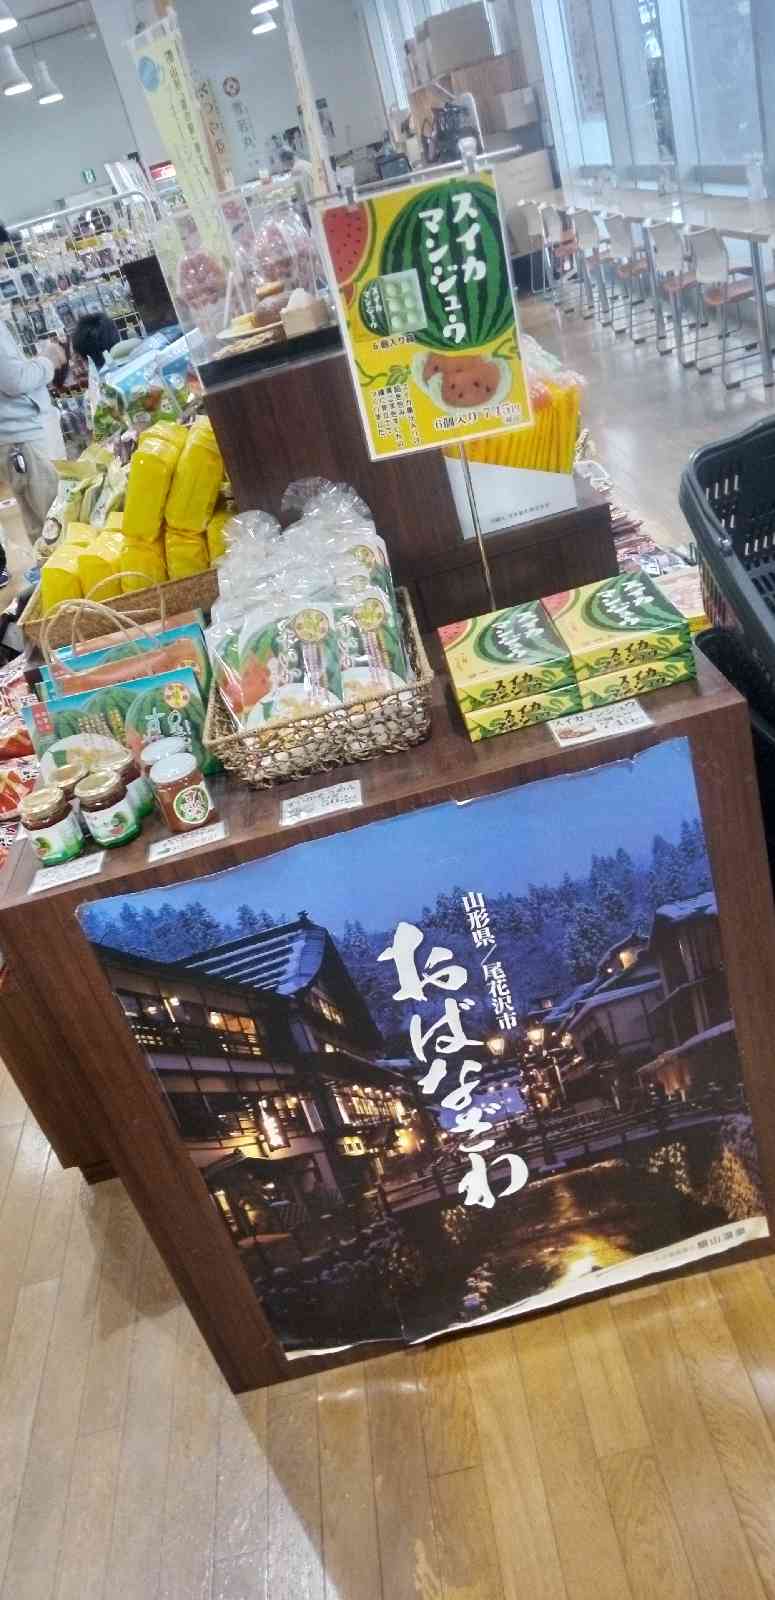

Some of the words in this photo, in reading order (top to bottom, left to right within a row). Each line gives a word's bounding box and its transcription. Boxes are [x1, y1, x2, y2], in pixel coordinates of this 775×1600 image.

[451, 192, 487, 284] スイカ
[418, 207, 467, 344] マンジュウ
[609, 638, 650, 660] スイカ
[495, 671, 534, 690] スイカ
[619, 667, 658, 687] スイカ
[503, 700, 542, 720] スイカ
[376, 921, 528, 1208] おばなざわ
